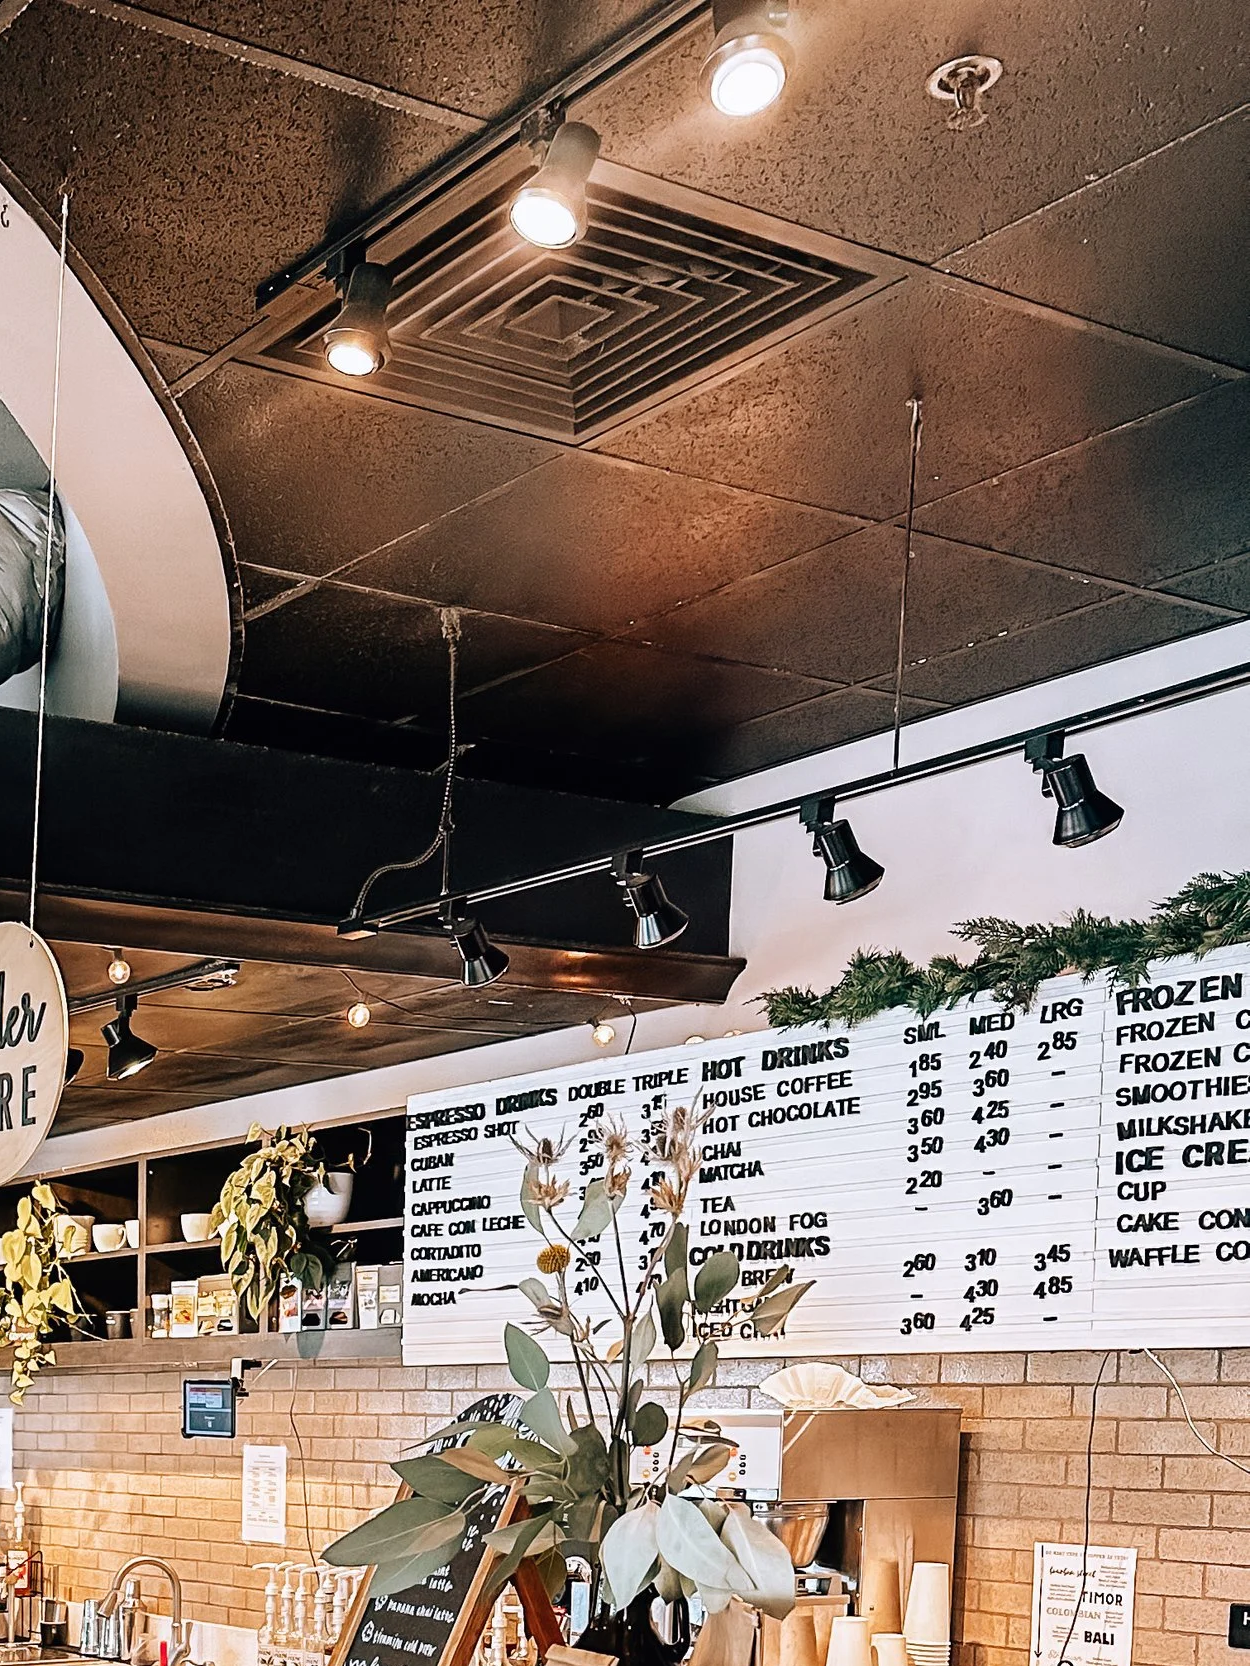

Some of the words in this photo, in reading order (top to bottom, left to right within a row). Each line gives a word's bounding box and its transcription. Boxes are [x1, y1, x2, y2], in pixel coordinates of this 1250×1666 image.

[1116, 973, 1243, 1015] FROZEN
[903, 1021, 947, 1044] SML
[969, 1012, 1015, 1035] MED
[1040, 998, 1084, 1023] LRG
[1116, 1011, 1215, 1046] FROZEN
[702, 1056, 746, 1082] HOT
[761, 1037, 850, 1071] DRINKS
[1119, 1046, 1221, 1074] FROZEN
[406, 1103, 486, 1131] ESPRESSO
[496, 1088, 558, 1116] DRINKS
[568, 1078, 627, 1101] DOUBLE
[632, 1068, 689, 1092] TRIPLE
[702, 1084, 766, 1110] HOUSE
[776, 1069, 853, 1097] COFFEE
[1115, 1075, 1250, 1106] SMOOTHIE
[702, 1115, 740, 1135] HOT
[748, 1097, 861, 1128] CHOCOLATE
[414, 1127, 478, 1150] ESPRESSO
[484, 1121, 520, 1138] SHOT
[411, 1153, 454, 1172] CUBAN
[702, 1141, 741, 1161] CHAI
[1115, 1145, 1165, 1175] ICE
[699, 1160, 765, 1184] MATCHA
[412, 1176, 452, 1194] LATTE
[1117, 1181, 1167, 1202] CUP
[411, 1195, 491, 1217] CAPPUCCINO
[700, 1196, 736, 1214] TEA
[411, 1223, 444, 1238] CAFE
[448, 1219, 476, 1236] CON
[482, 1215, 526, 1232] LECHE
[700, 1216, 776, 1237] LONDON
[789, 1211, 828, 1231] FOG
[1116, 1211, 1180, 1233] CAKE
[410, 1244, 482, 1261] CORTADITO
[746, 1235, 831, 1261] DRINKS
[1108, 1244, 1200, 1268] WAFFLE
[411, 1265, 484, 1282] AMERICANO
[411, 1291, 457, 1306] MOCHA
[1082, 1590, 1123, 1607] TIMOR
[1084, 1631, 1115, 1646] BALI
